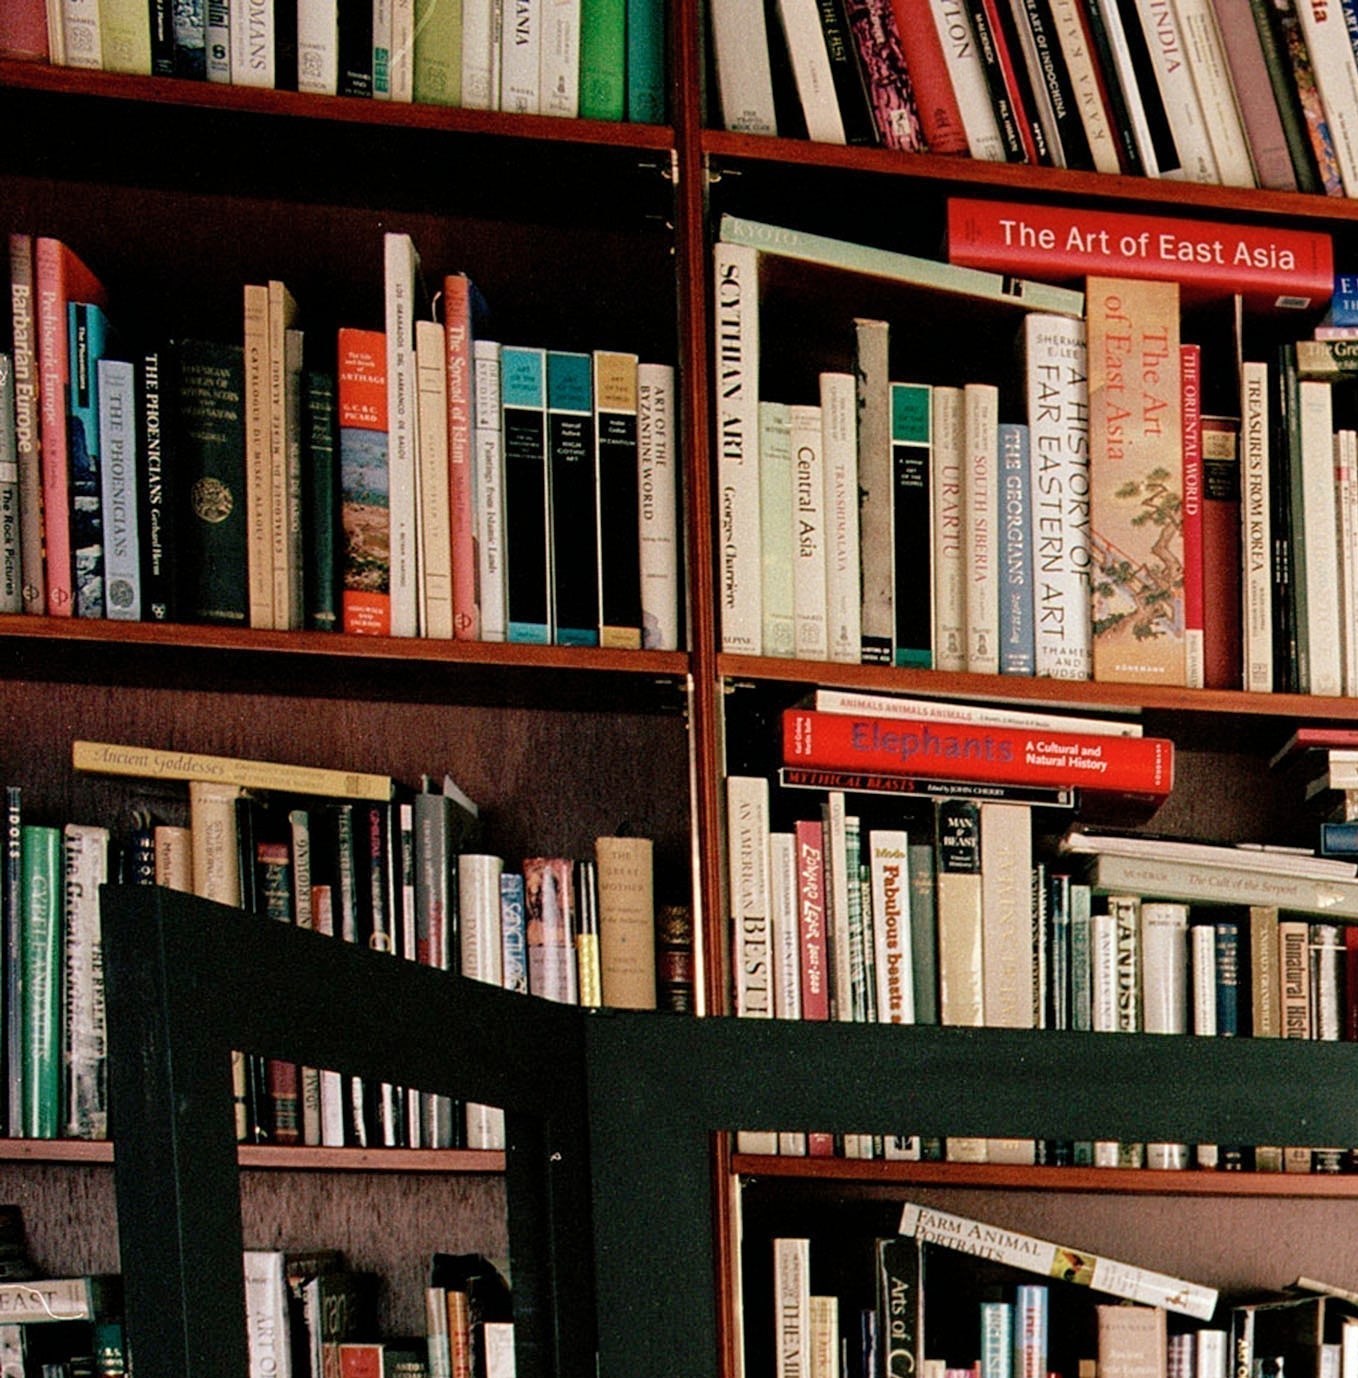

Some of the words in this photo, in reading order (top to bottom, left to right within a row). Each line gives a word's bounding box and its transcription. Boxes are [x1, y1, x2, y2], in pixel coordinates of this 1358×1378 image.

[1029, 15, 1043, 33] ART
[1036, 35, 1046, 50] OF
[1041, 52, 1066, 119] INDOCHINA
[999, 220, 1056, 248] The
[1066, 228, 1111, 255] Art
[1124, 234, 1150, 258] of
[1160, 233, 1224, 264] East
[1233, 242, 1295, 271] Asia
[10, 283, 35, 378] Barbarian
[1103, 294, 1123, 321] of
[1105, 326, 1133, 394] East
[1142, 325, 1169, 380] The
[653, 386, 665, 414] ART
[1037, 364, 1061, 423] FAR
[1067, 366, 1088, 388] A
[15, 382, 33, 454] Europe
[108, 392, 123, 427] THE
[640, 385, 652, 459] BYZANTINE
[654, 417, 666, 434] OF
[1106, 400, 1124, 461] Asia
[1142, 387, 1169, 439] Art
[656, 437, 667, 468] THE
[1068, 397, 1090, 541] HISTORY
[110, 432, 127, 558] PHOENICIANS
[642, 461, 653, 521] WORLD
[796, 446, 816, 516] Central
[1038, 434, 1064, 574] EASTERN
[942, 464, 960, 560] URARTU
[799, 519, 817, 559] Asia
[1070, 545, 1090, 585] OF
[1040, 582, 1066, 640] ART
[850, 721, 1014, 763] Elephants
[1025, 741, 1035, 753] A
[1025, 753, 1065, 768] Natural
[1037, 742, 1079, 756] Cultural
[1068, 757, 1108, 773] History
[1080, 745, 1101, 757] and
[788, 770, 863, 789] MYTHICAL
[865, 775, 916, 792] BEASTS
[916, 1209, 962, 1235] FARM
[968, 1223, 1042, 1258] ANIMAL
[890, 1276, 909, 1316] Arts
[254, 1309, 274, 1354] ART
[892, 1321, 909, 1341] of
